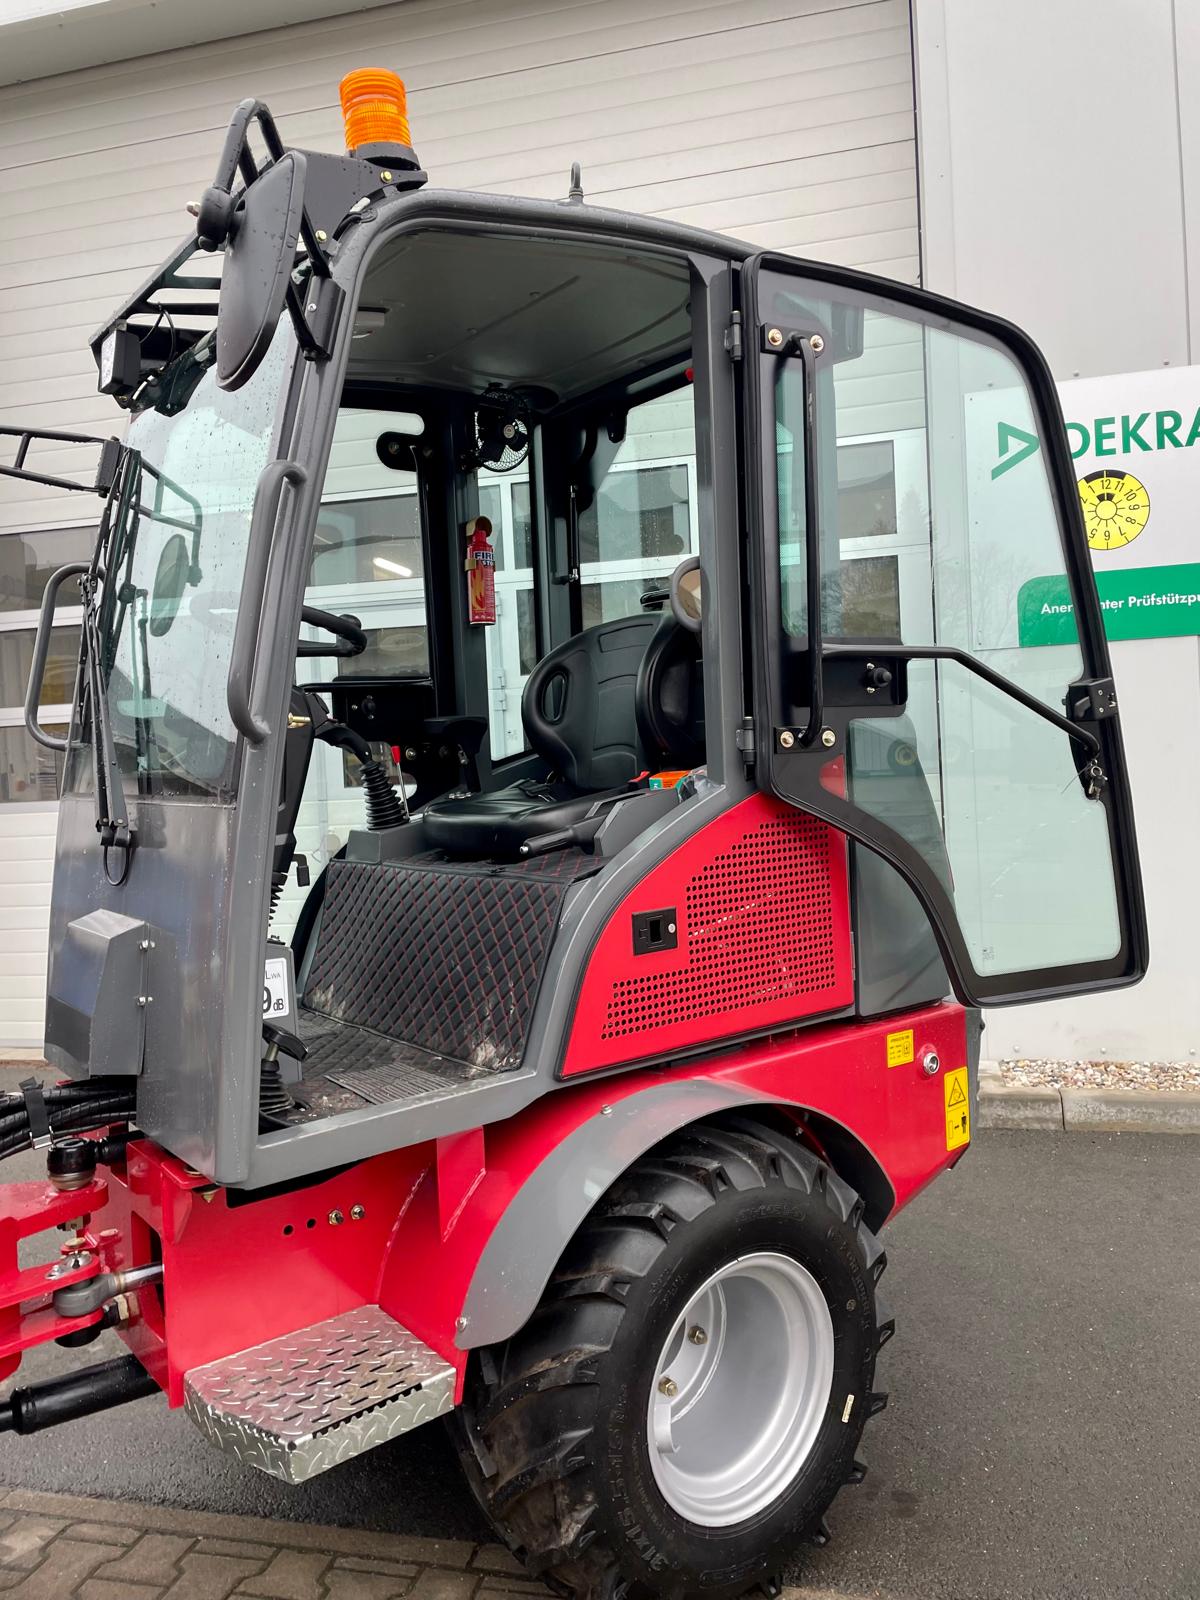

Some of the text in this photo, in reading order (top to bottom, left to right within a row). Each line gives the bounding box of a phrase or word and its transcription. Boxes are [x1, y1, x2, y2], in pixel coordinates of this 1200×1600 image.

[1088, 485, 1095, 494] 1
[1100, 479, 1111, 490] 12
[1115, 480, 1125, 492] 11
[1124, 489, 1137, 502] 10
[1125, 516, 1137, 525] 8
[1089, 528, 1098, 539] 5
[1104, 530, 1111, 541] 6
[1119, 526, 1127, 536] 7
[474, 551, 494, 560] FIR
[1041, 599, 1124, 614] Anernter
[273, 998, 284, 1011] dB
